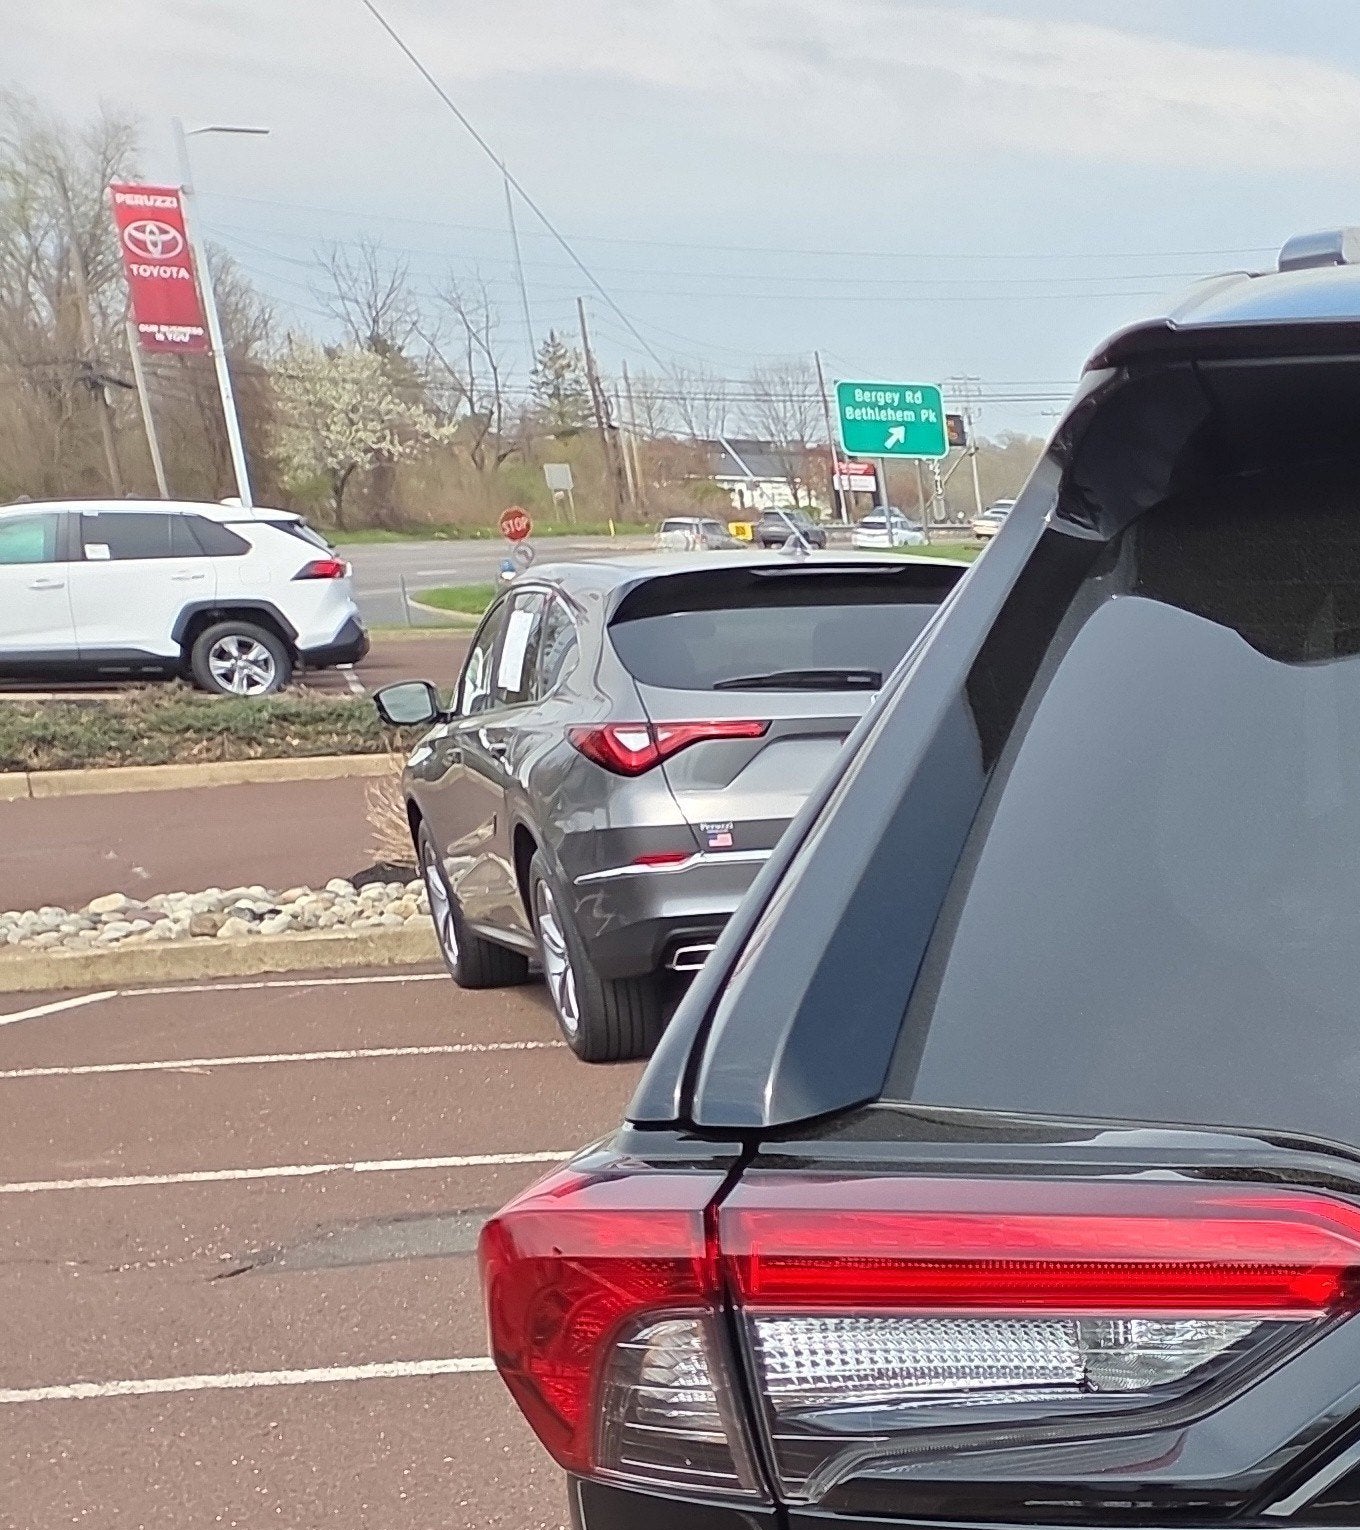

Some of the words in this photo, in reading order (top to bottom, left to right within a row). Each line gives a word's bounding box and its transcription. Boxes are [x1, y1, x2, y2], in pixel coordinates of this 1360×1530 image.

[115, 192, 177, 208] PERUZZI
[130, 263, 190, 280] TOYOTA
[854, 388, 900, 406] Bergey
[905, 390, 923, 404] Rd
[845, 406, 916, 422] Bethlehem
[920, 408, 937, 423] Pk
[502, 516, 529, 535] STOP
